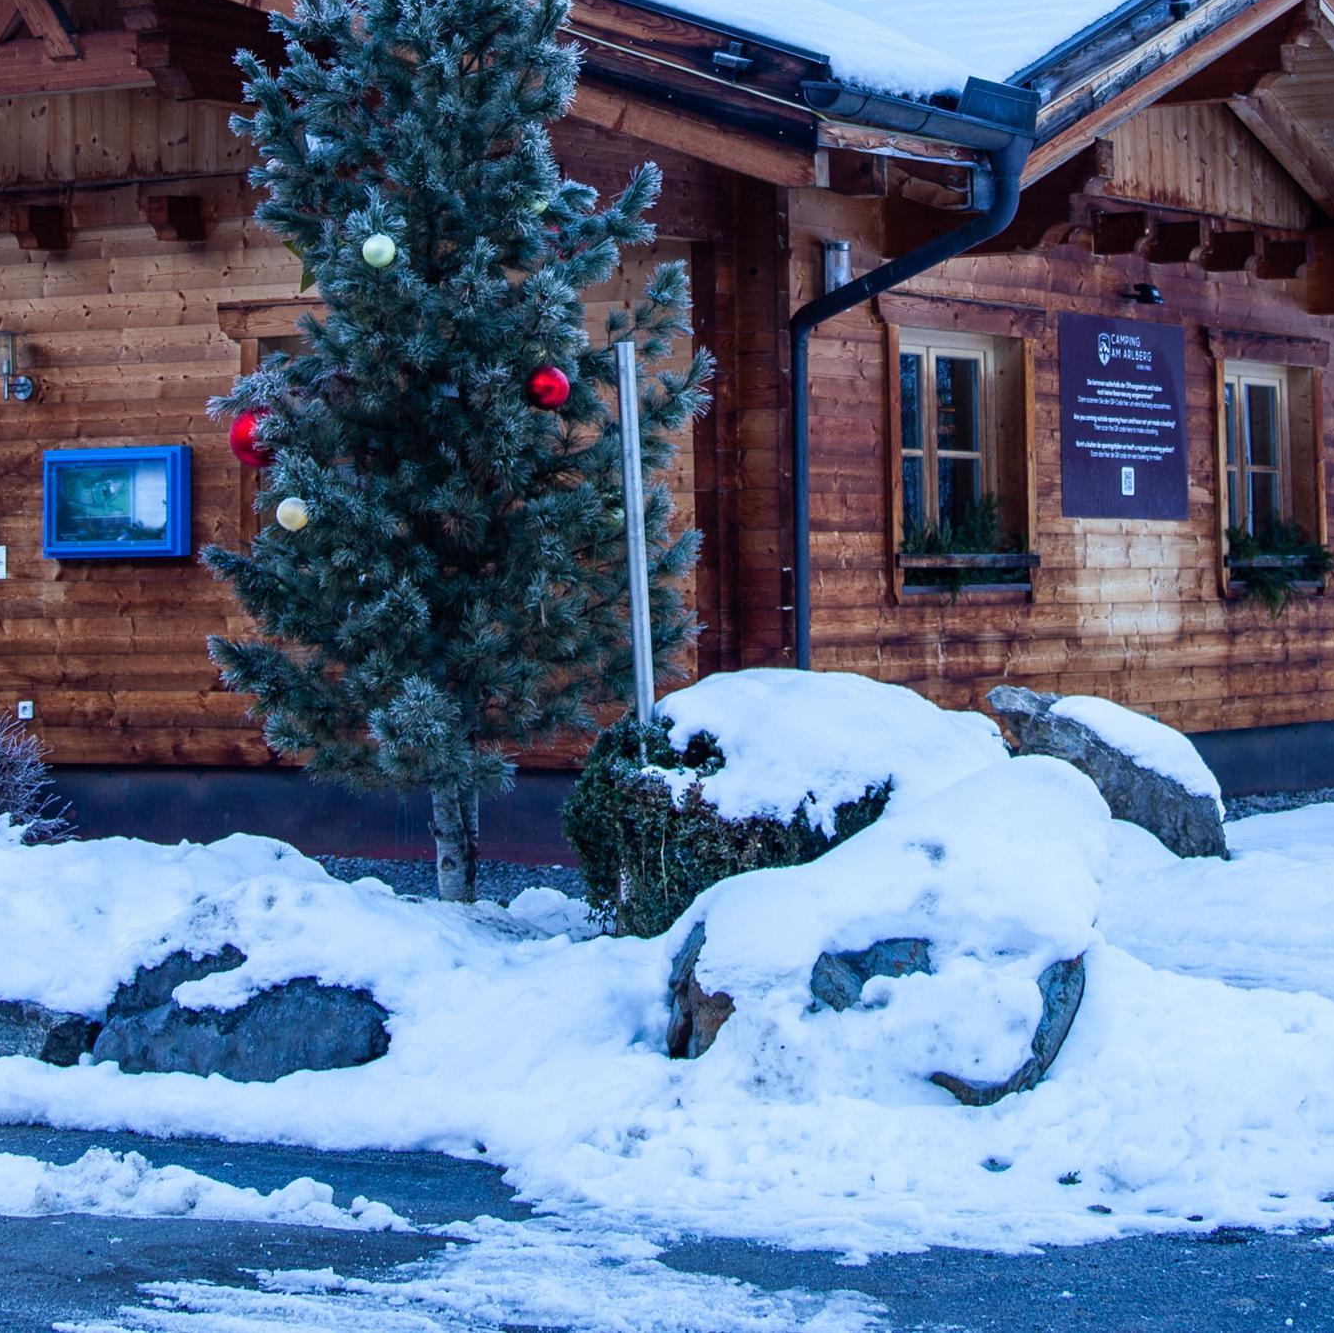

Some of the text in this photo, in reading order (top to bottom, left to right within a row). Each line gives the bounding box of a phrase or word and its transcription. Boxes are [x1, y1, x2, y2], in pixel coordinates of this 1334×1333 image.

[1111, 334, 1141, 348] CAMPING
[1111, 348, 1152, 362] AM ARLBERG
